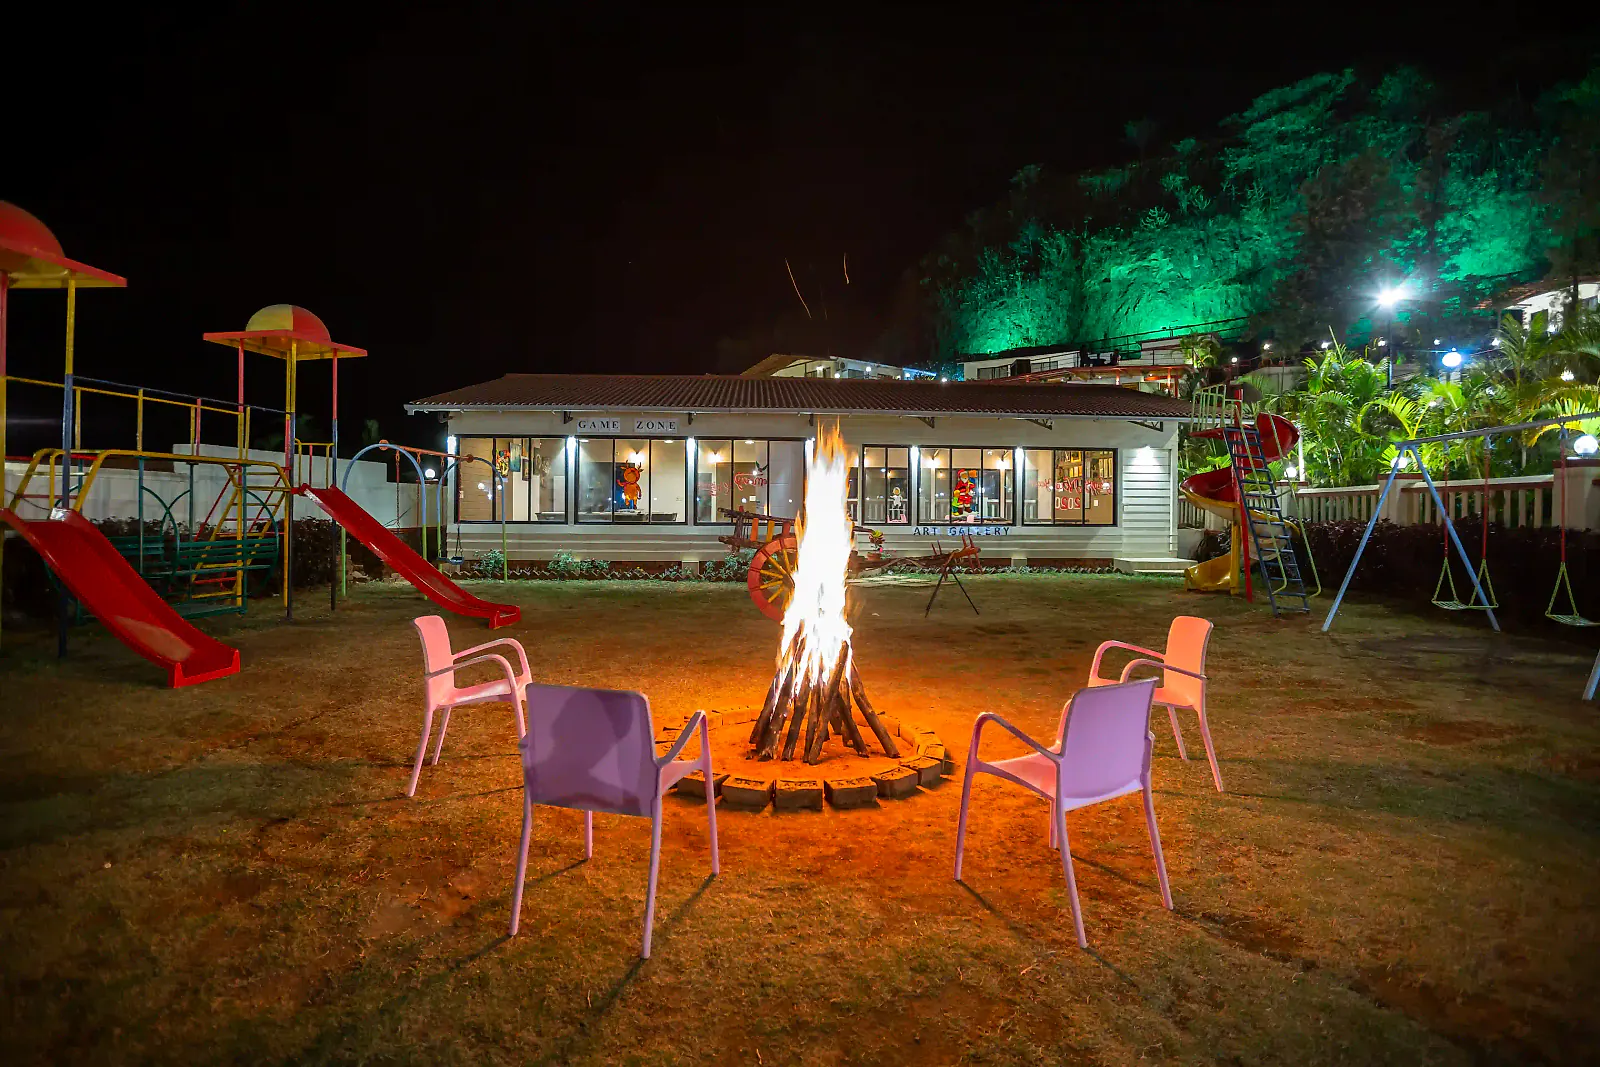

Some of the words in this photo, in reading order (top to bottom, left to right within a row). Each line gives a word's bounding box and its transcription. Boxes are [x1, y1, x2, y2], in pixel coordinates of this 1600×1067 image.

[578, 420, 619, 429] GAME
[636, 420, 676, 430] ZONE
[913, 527, 937, 536] ART
[949, 526, 1010, 536] GALLERY
